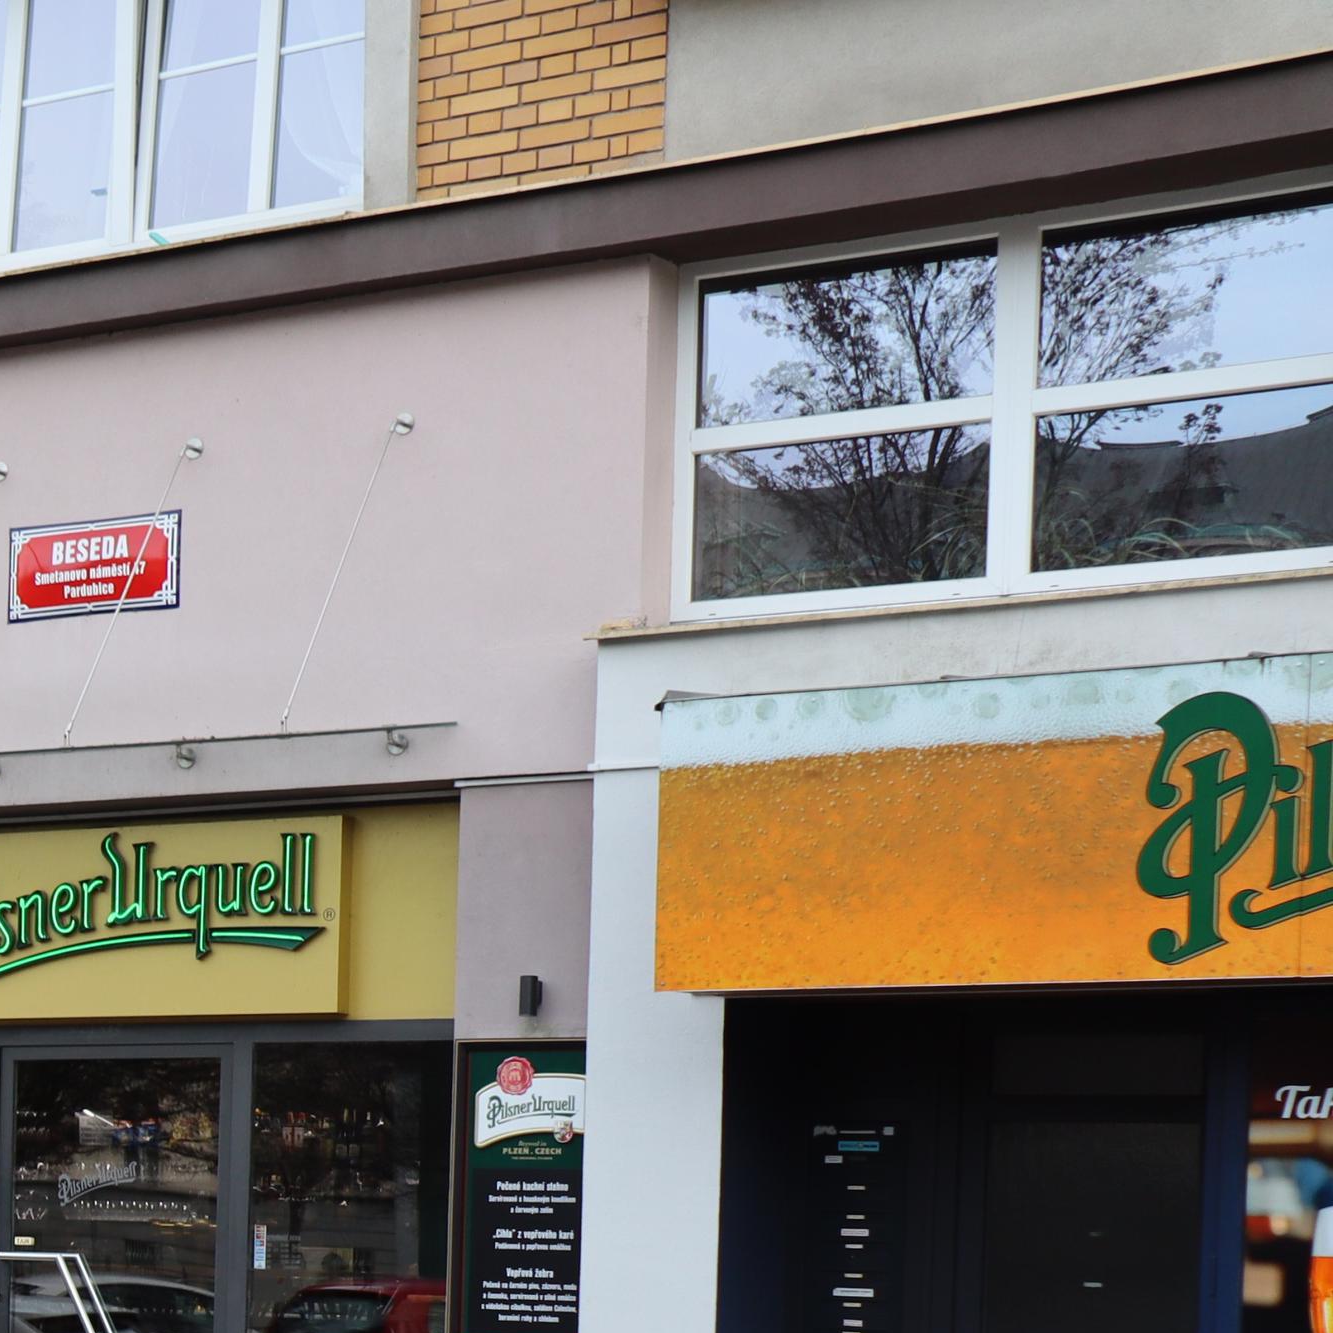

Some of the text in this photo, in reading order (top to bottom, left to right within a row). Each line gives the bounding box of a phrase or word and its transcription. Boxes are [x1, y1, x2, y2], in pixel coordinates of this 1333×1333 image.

[52, 534, 129, 566] BESEDA
[35, 567, 88, 586] Smetanovo
[89, 561, 131, 580] náměstí
[64, 582, 115, 599] Pardubice
[99, 832, 317, 960] Urquell
[486, 1094, 576, 1129] Pilsner Urquell
[534, 1147, 562, 1156] CZECH
[57, 1173, 97, 1207] Pilsner
